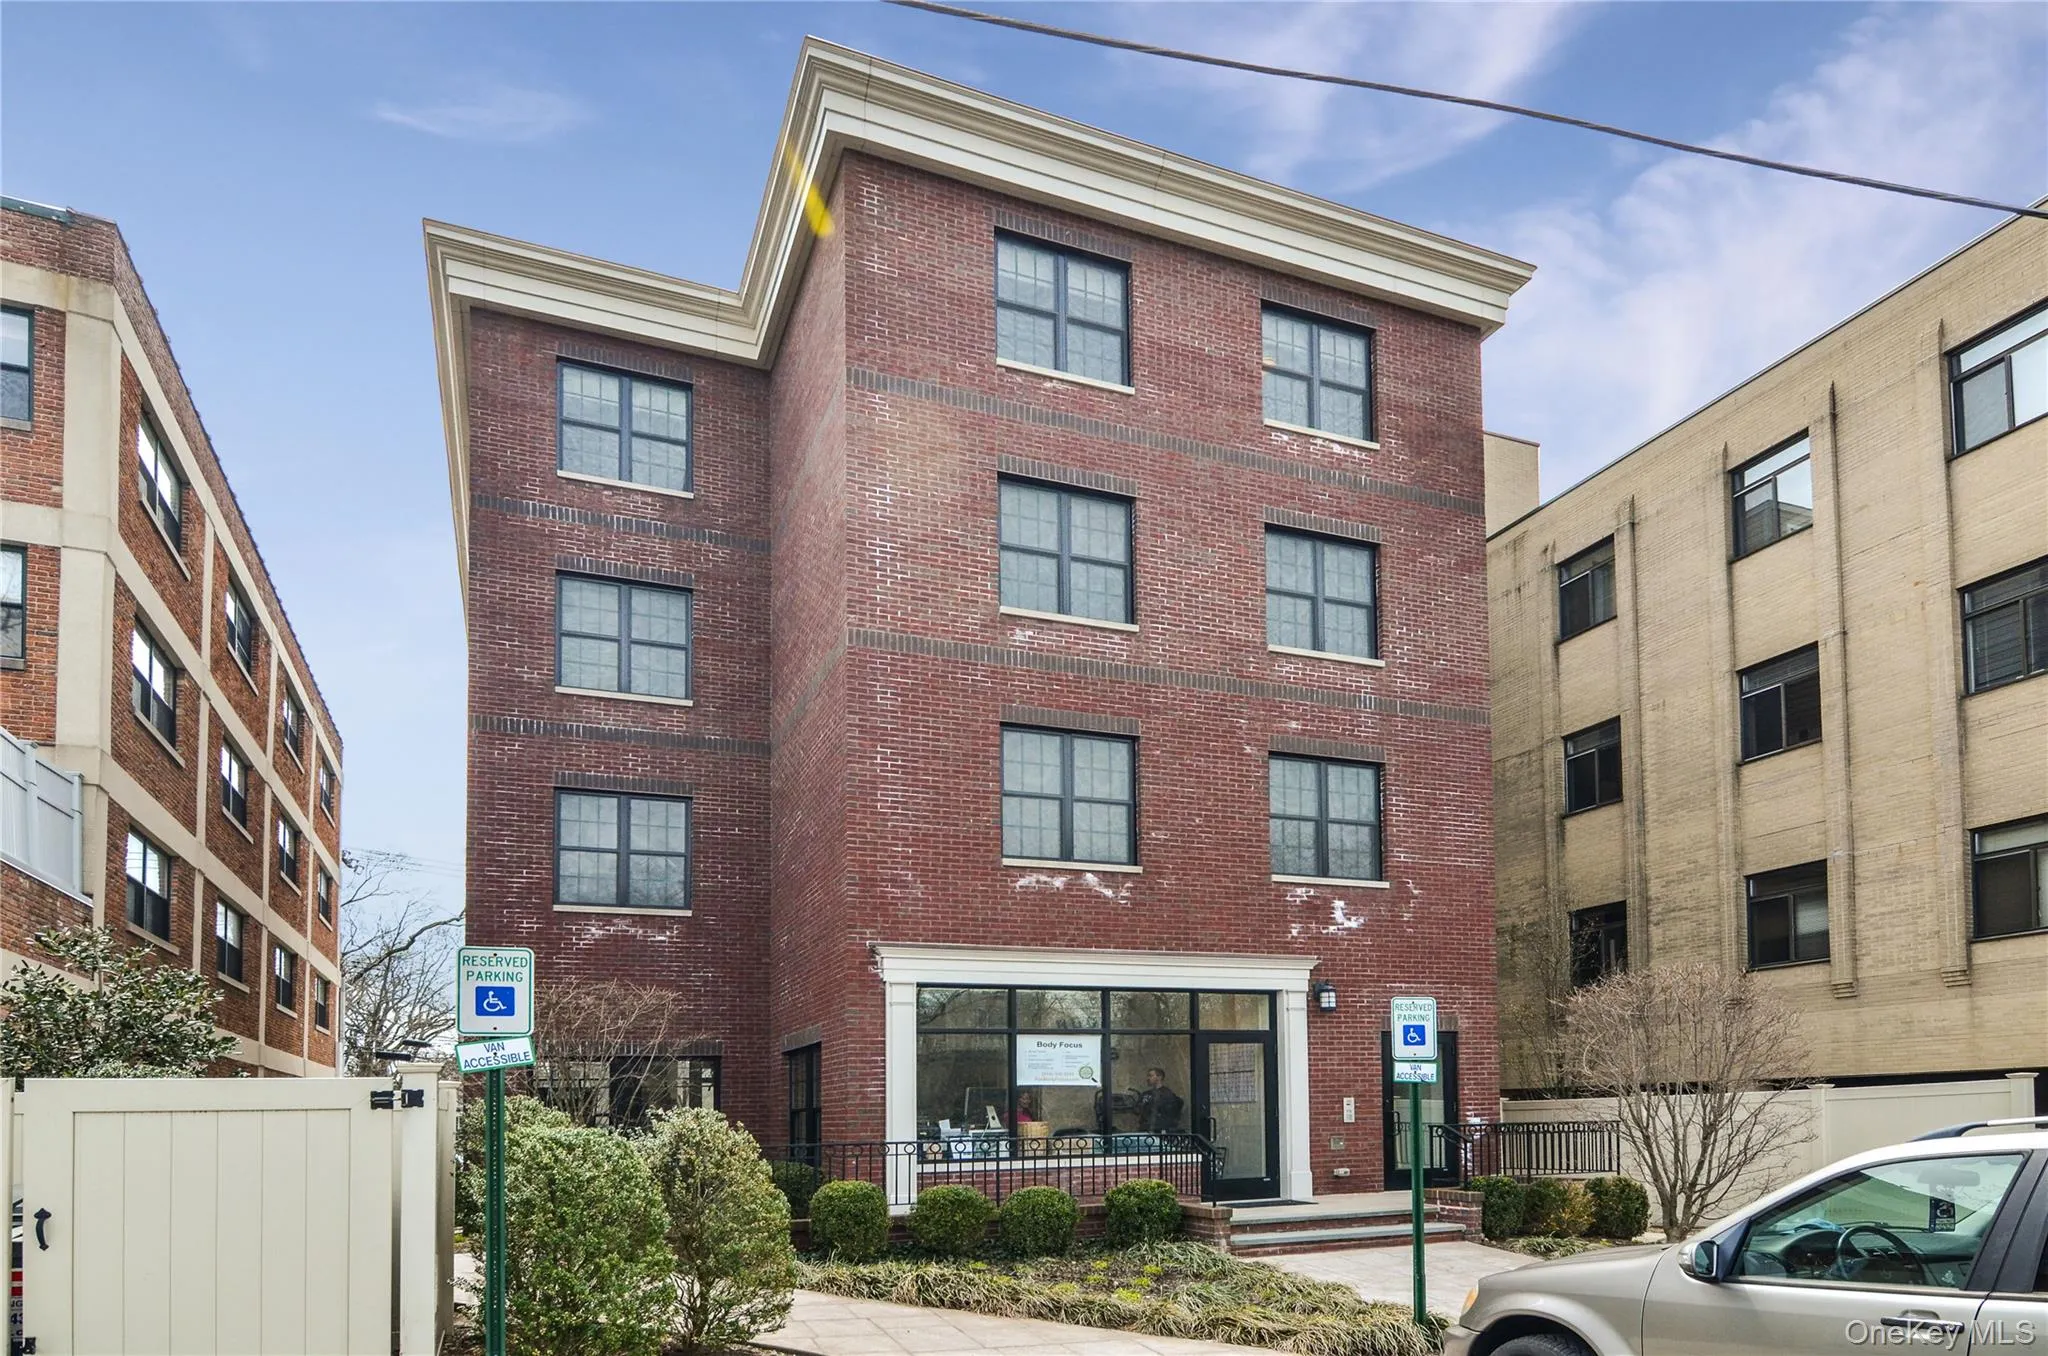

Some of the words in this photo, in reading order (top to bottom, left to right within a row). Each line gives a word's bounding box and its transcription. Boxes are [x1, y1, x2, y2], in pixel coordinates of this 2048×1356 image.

[462, 955, 528, 968] RESERVED
[466, 970, 523, 982] PARKING
[1395, 1003, 1432, 1012] RESERVED
[1397, 1013, 1430, 1021] PARKING
[484, 1042, 505, 1053] VAN
[1037, 1041, 1057, 1049] Body
[463, 1051, 531, 1069] ACCESSIBLE
